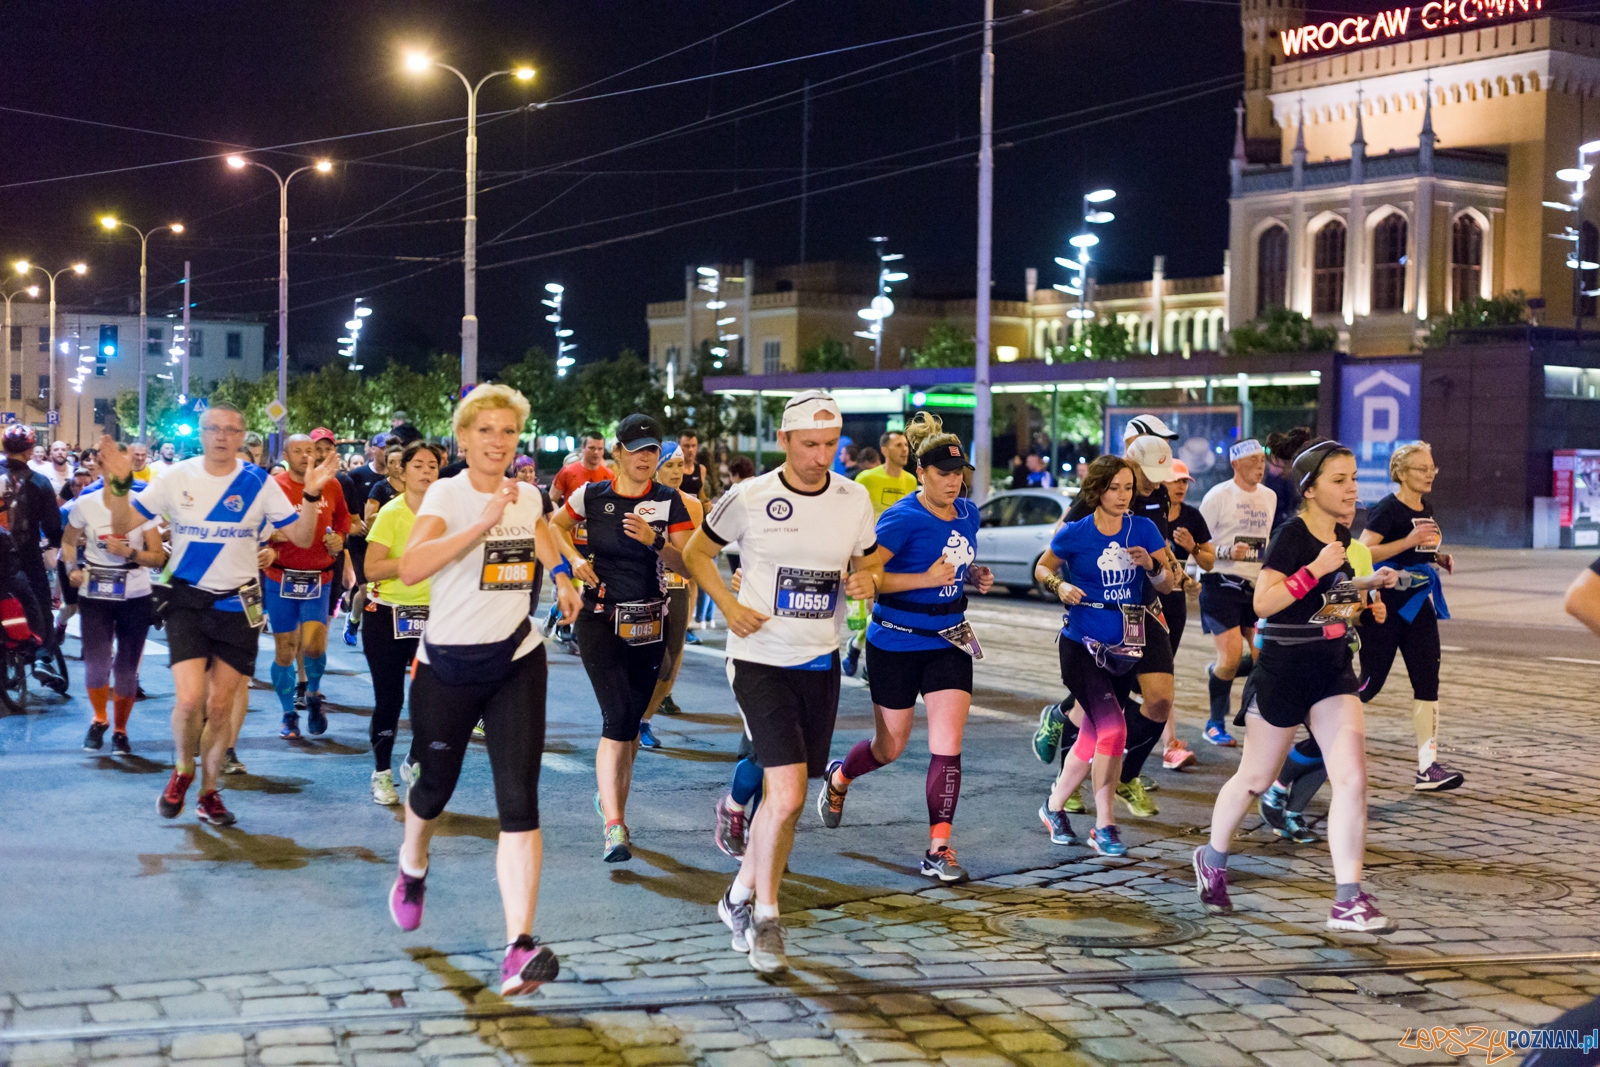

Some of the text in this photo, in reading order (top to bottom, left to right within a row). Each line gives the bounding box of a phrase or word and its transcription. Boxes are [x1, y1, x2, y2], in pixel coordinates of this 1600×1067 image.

[1281, 7, 1410, 56] WROCŁAW
[772, 504, 788, 514] PZU
[175, 522, 209, 539] Termy
[497, 564, 528, 581] 7086
[293, 583, 309, 594] 367
[1104, 588, 1131, 601] GOSIA
[789, 592, 830, 610] 10559
[630, 624, 653, 637] 4045
